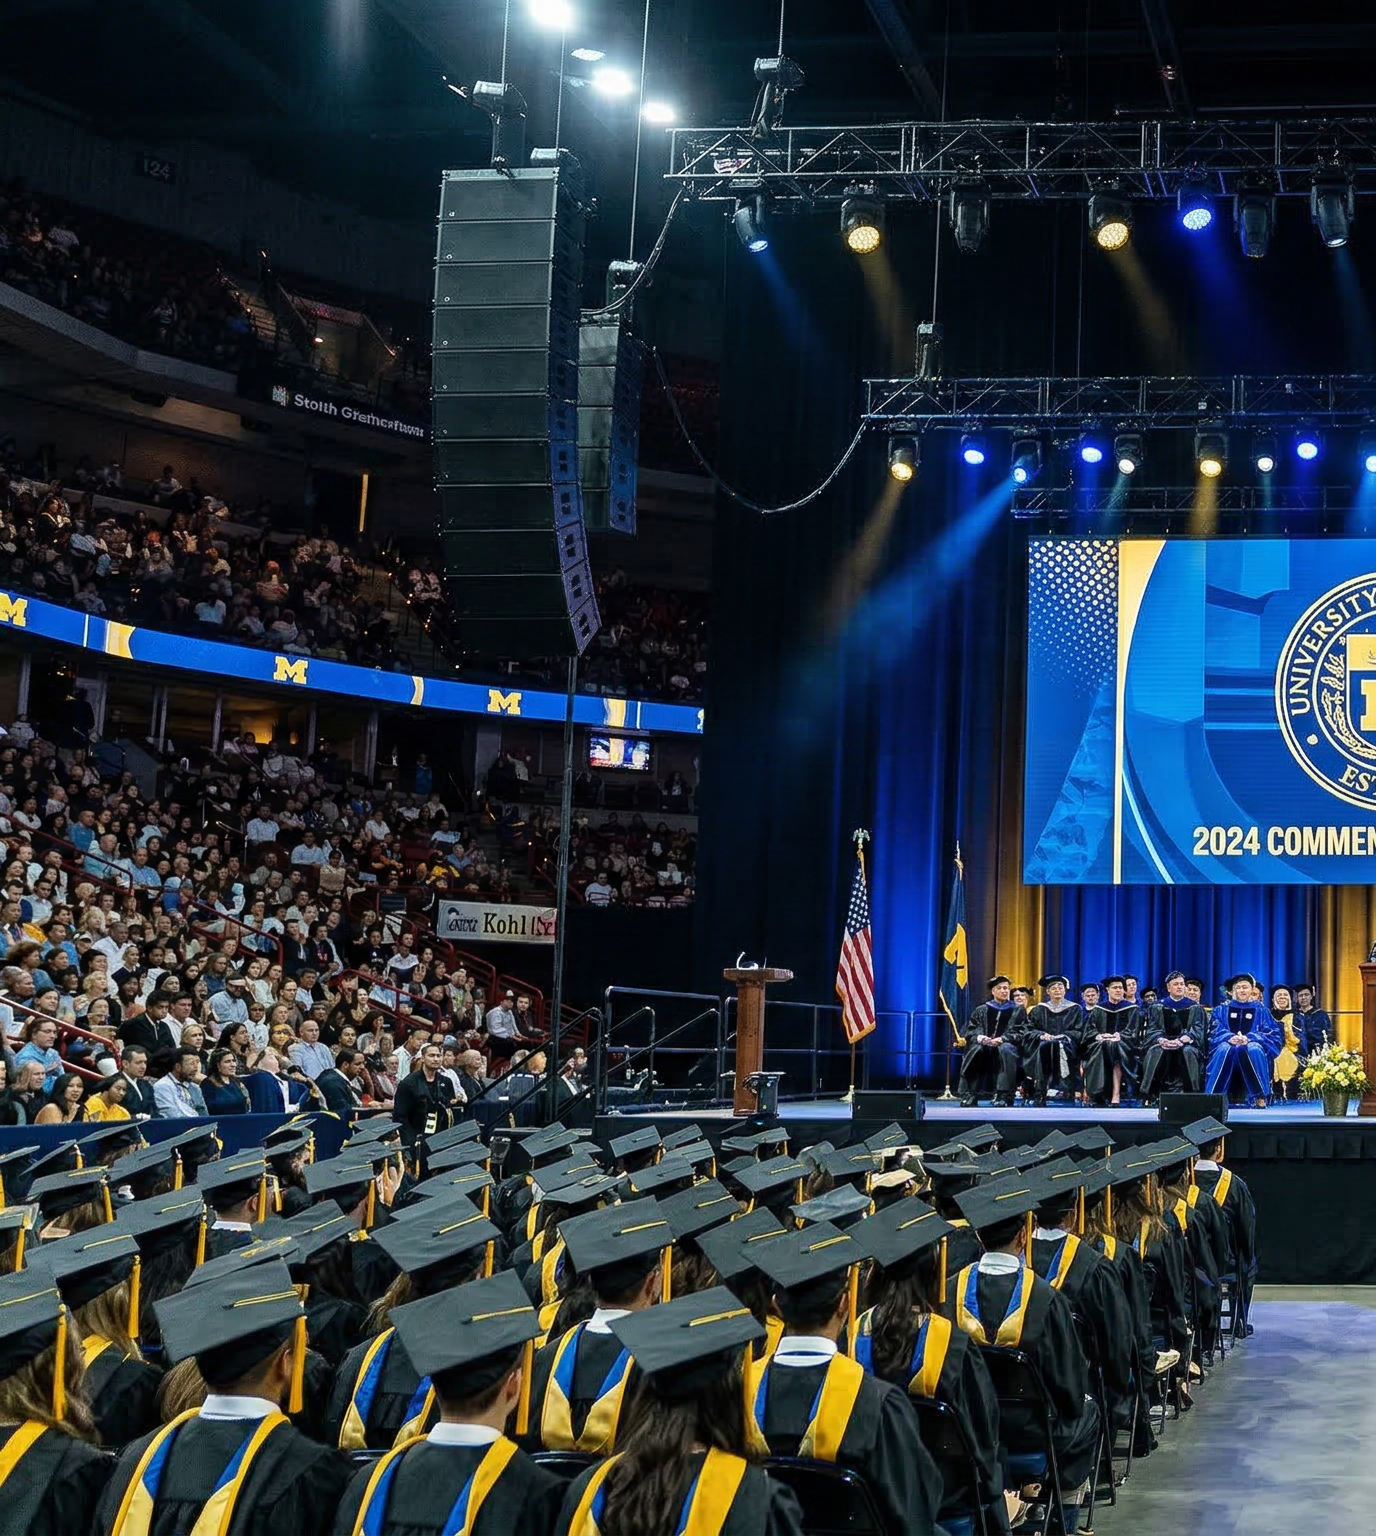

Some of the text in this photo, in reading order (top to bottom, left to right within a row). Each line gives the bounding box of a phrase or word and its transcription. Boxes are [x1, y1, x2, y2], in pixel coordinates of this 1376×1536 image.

[0, 593, 27, 627] M
[274, 656, 308, 684] M
[488, 690, 521, 715] M
[1193, 826, 1261, 856] 2024
[483, 912, 527, 935] Kohl
